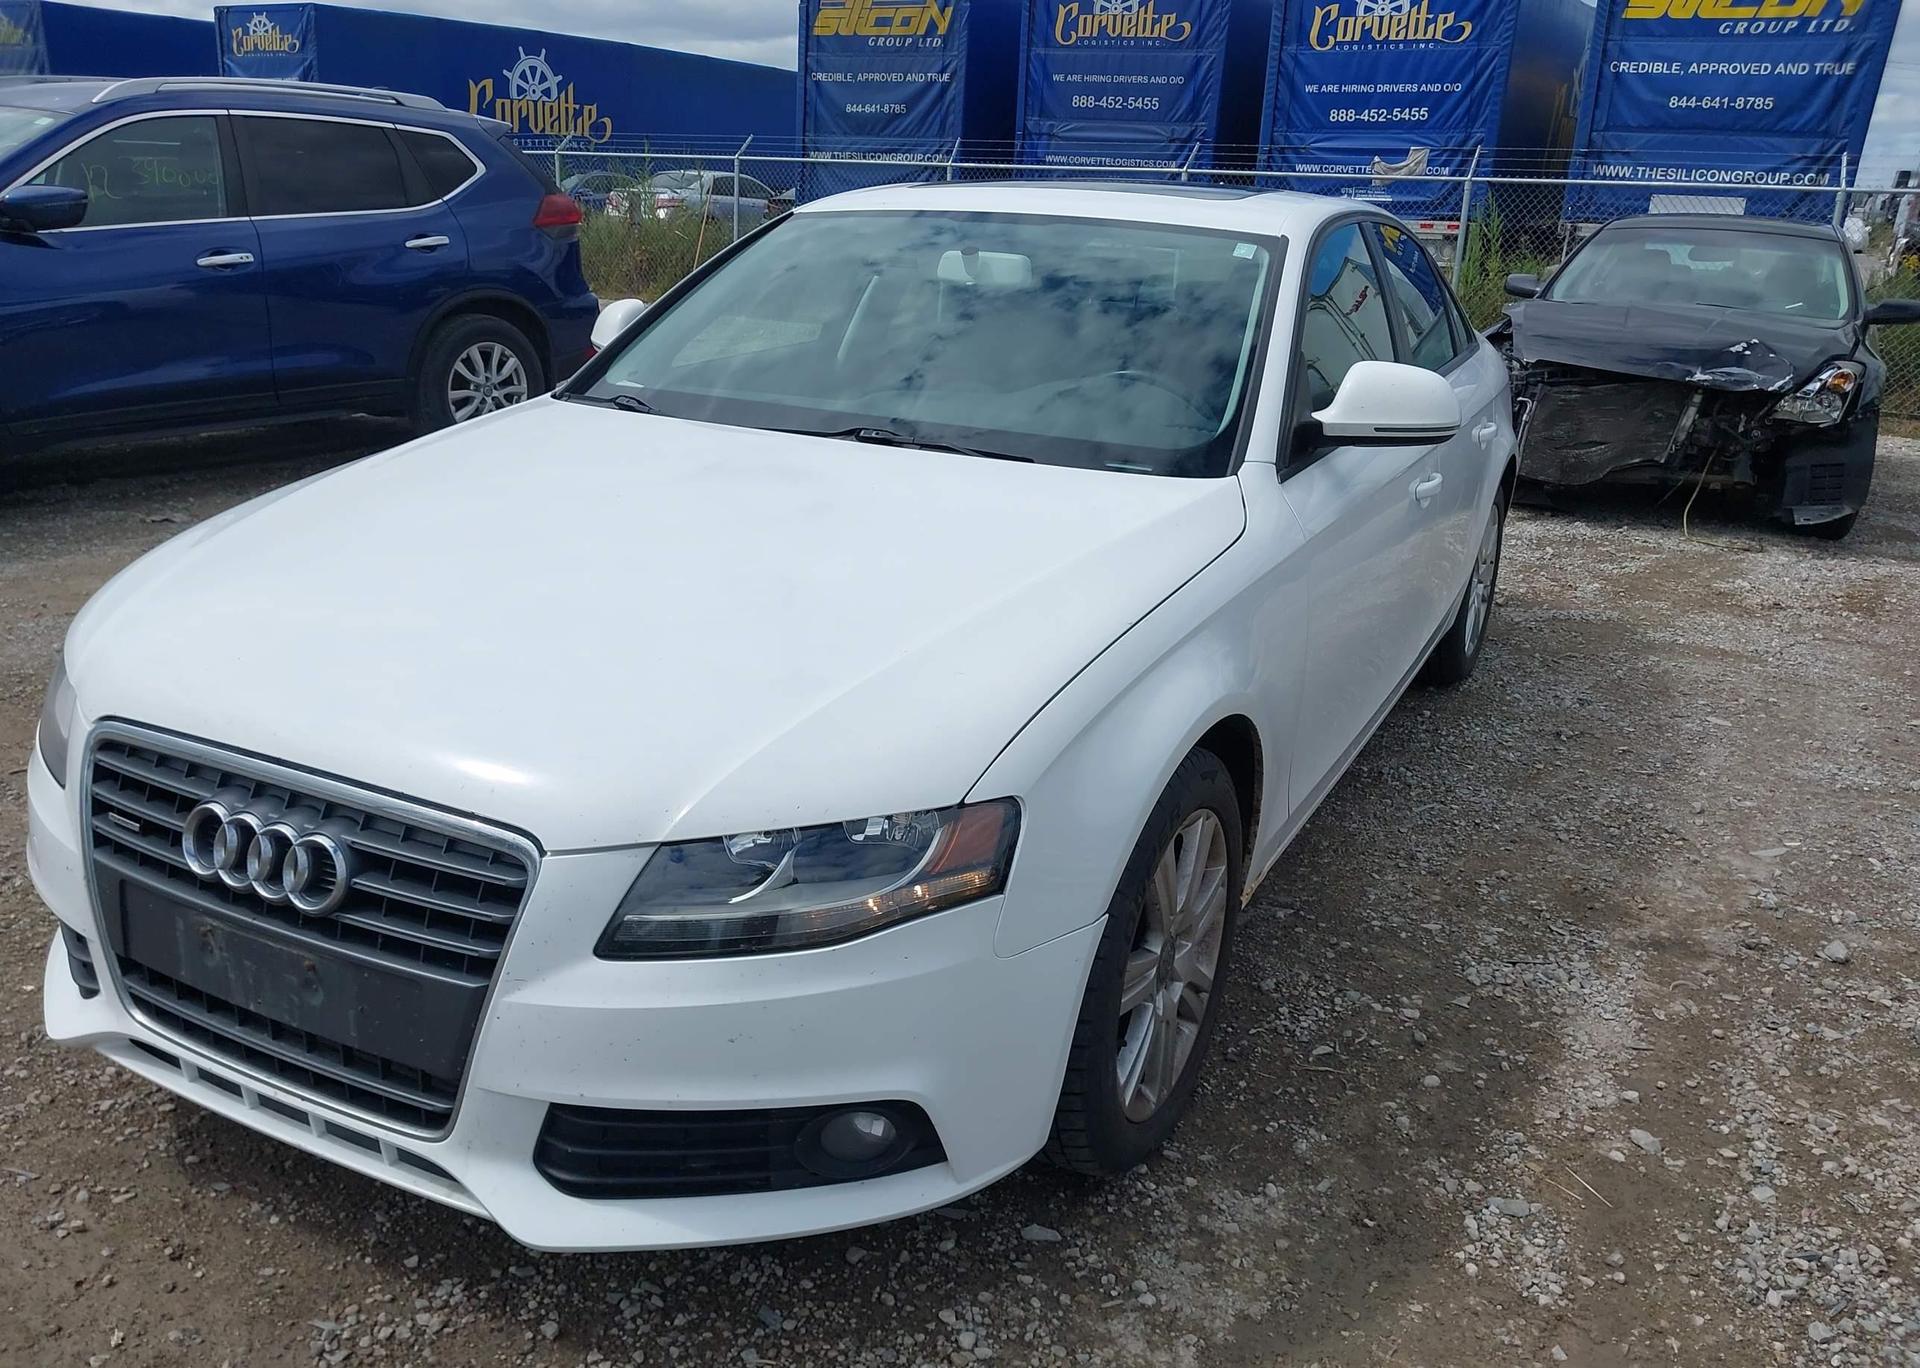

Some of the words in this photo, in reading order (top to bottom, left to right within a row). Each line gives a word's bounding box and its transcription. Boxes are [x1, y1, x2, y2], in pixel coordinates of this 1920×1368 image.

[1055, 0, 1192, 46] Corvette
[1309, 0, 1473, 51] Corvette
[1718, 20, 1799, 35] GROUP
[1807, 19, 1856, 34] LTD.
[231, 24, 300, 57] Corvette
[868, 36, 913, 47] GROUP
[918, 37, 945, 48] LTD.
[1077, 39, 1135, 47] LOGISTICS
[1335, 43, 1404, 51] LOGISTICS
[1610, 61, 1684, 76] CREDIBLE,
[1688, 62, 1772, 75] APPROVED
[1774, 63, 1809, 75] AND
[1814, 63, 1856, 76] TRUE
[811, 72, 855, 84] CREDIBLE,
[857, 73, 904, 82] APPROVED
[905, 73, 925, 82] AND
[927, 73, 951, 82] TRUE
[1052, 74, 1065, 82] WE
[1066, 74, 1082, 82] ARE
[1084, 74, 1112, 83] HIRING
[1113, 75, 1149, 84] DRIVERS
[1150, 75, 1168, 84] AND
[1169, 75, 1185, 85] O/O
[1305, 84, 1319, 93] WE
[1320, 84, 1340, 93] ARE
[1341, 84, 1375, 93] HIRING
[1377, 83, 1418, 93] DRIVERS
[1419, 83, 1442, 92] AND
[1443, 82, 1462, 92] O/O
[845, 103, 907, 114] 844-641-8785
[1071, 95, 1160, 110] 888-452-5455
[1668, 95, 1774, 110] 844-641-8785
[1329, 107, 1429, 122] 888-452-5455
[809, 151, 948, 163] WWW.THESILICONGROUP.COM
[1045, 154, 1176, 168] WWW.CORVETTELOGISTICS.COM
[1592, 164, 1831, 187] WWW.THESILICONGROUP.COM
